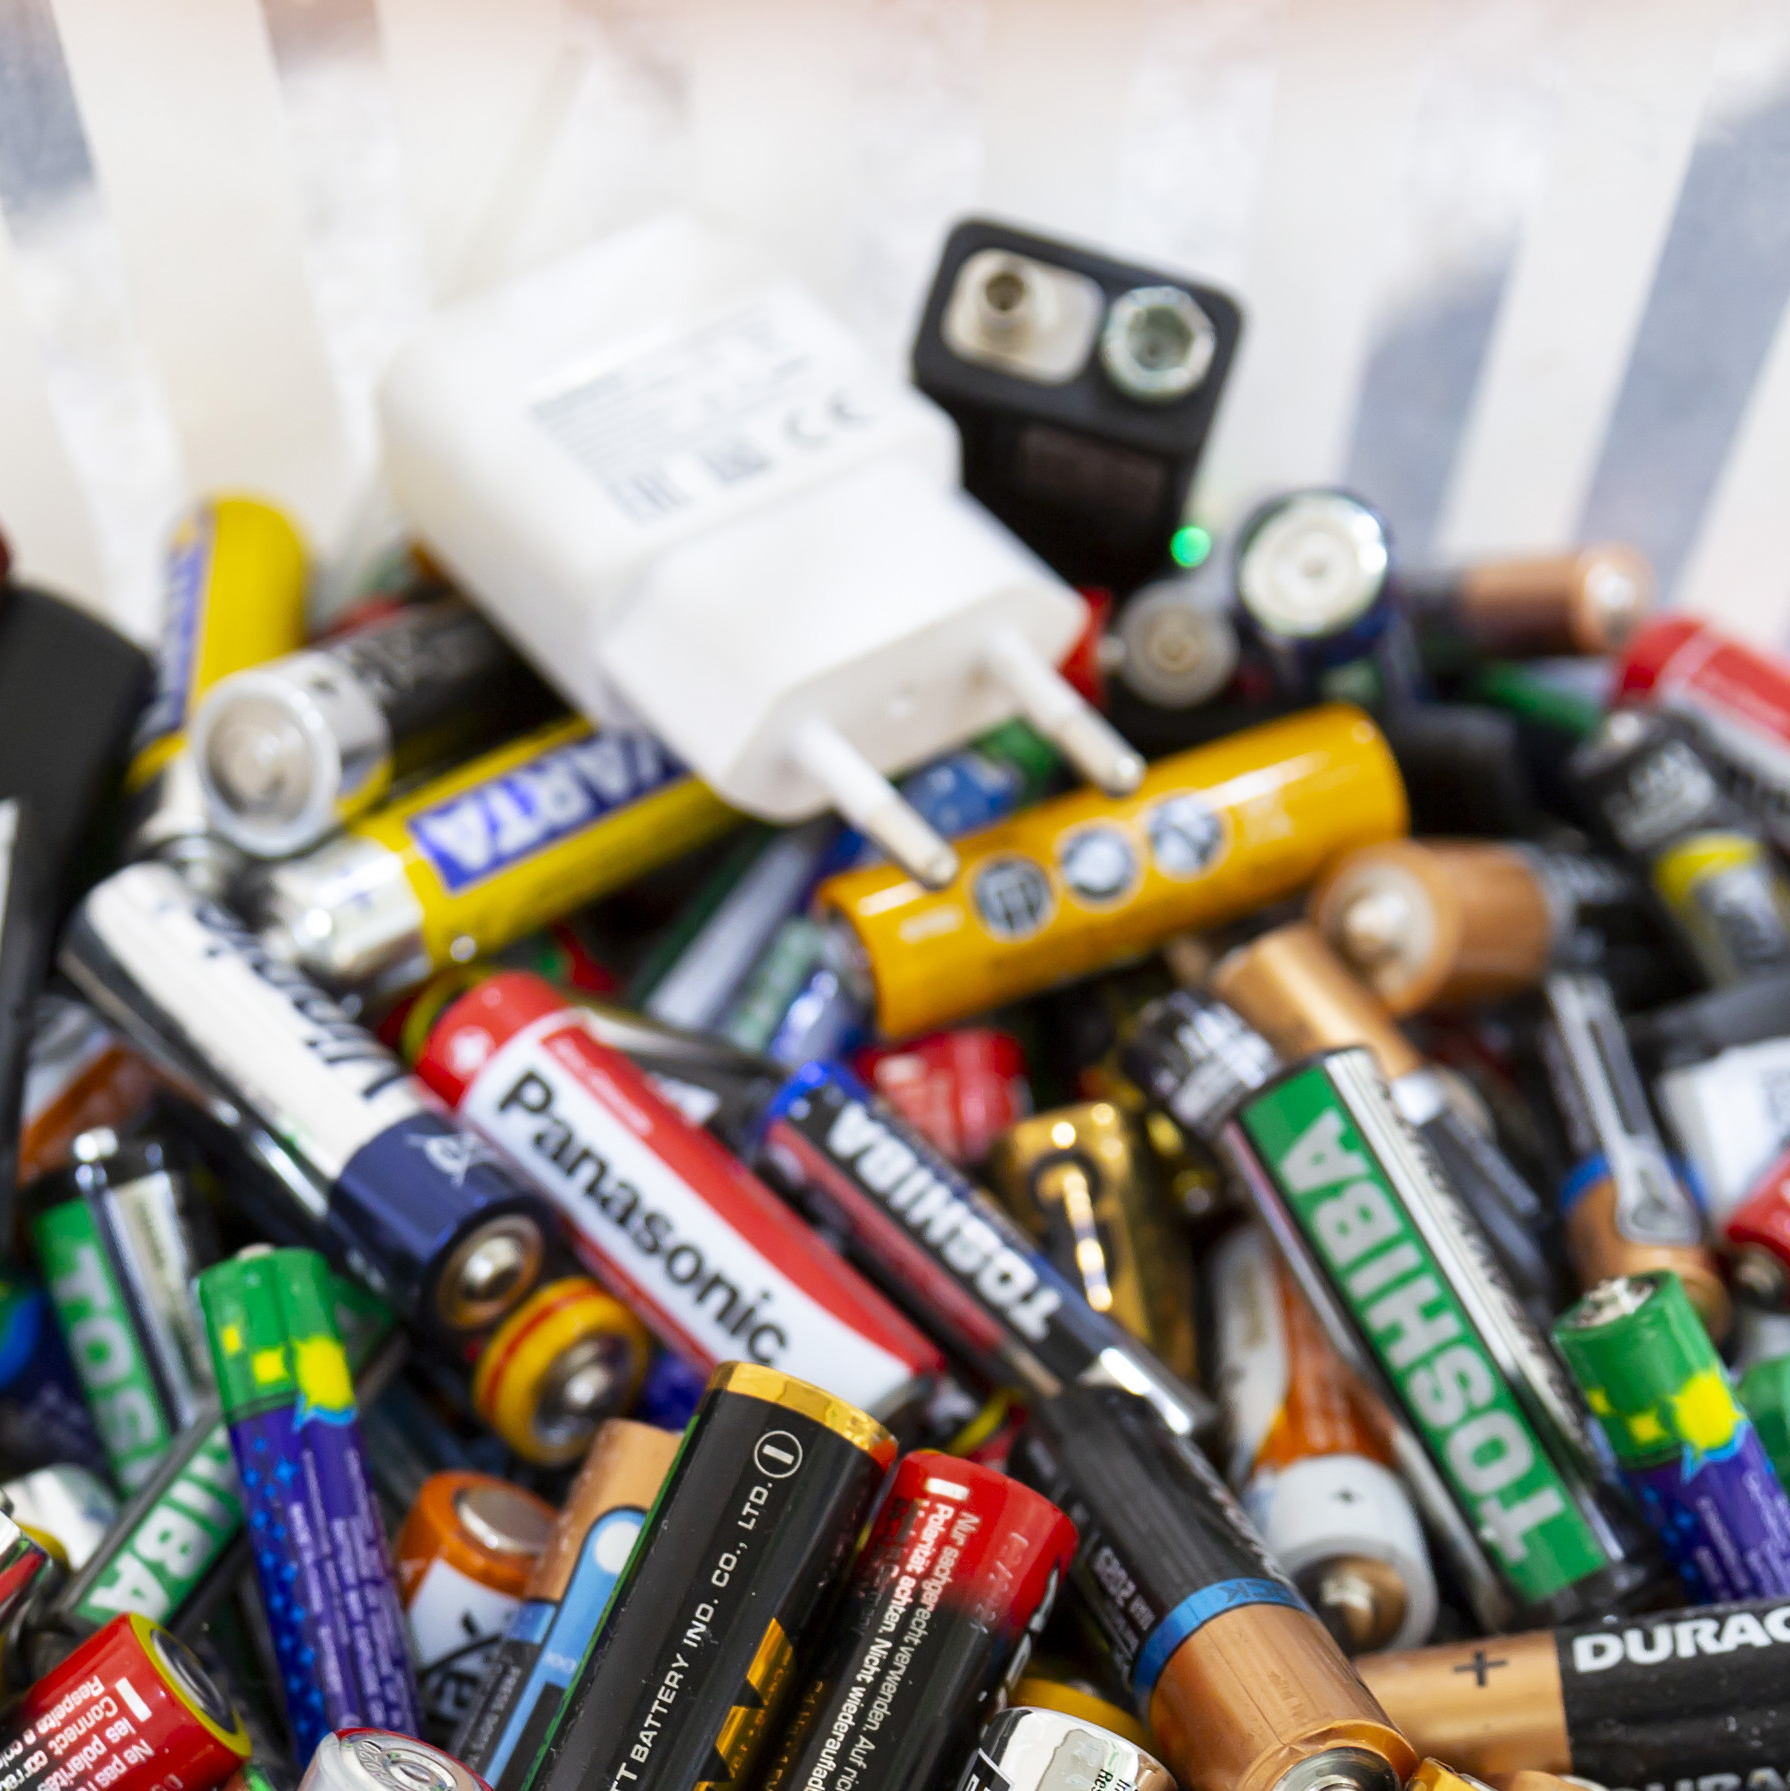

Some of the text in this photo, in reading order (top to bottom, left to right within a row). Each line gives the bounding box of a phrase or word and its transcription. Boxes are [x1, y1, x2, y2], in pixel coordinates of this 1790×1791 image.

[419, 733, 667, 870] ARTA
[498, 1072, 790, 1367] Panasonic
[825, 1103, 1062, 1341] TOSHIBA
[1281, 1109, 1565, 1562] TOSHIBA
[901, 1500, 956, 1576] Polarität
[945, 1508, 982, 1549] Nur
[624, 1652, 698, 1763] BATTERY
[681, 1594, 721, 1648] IND.
[708, 1536, 749, 1590] CO.,
[735, 1476, 777, 1531] LTD.
[873, 1574, 921, 1640] achten.
[896, 1543, 970, 1649] sachgerecht
[853, 1635, 893, 1686] Nicht
[857, 1643, 923, 1738] verwenden.
[845, 1734, 876, 1769] Auf
